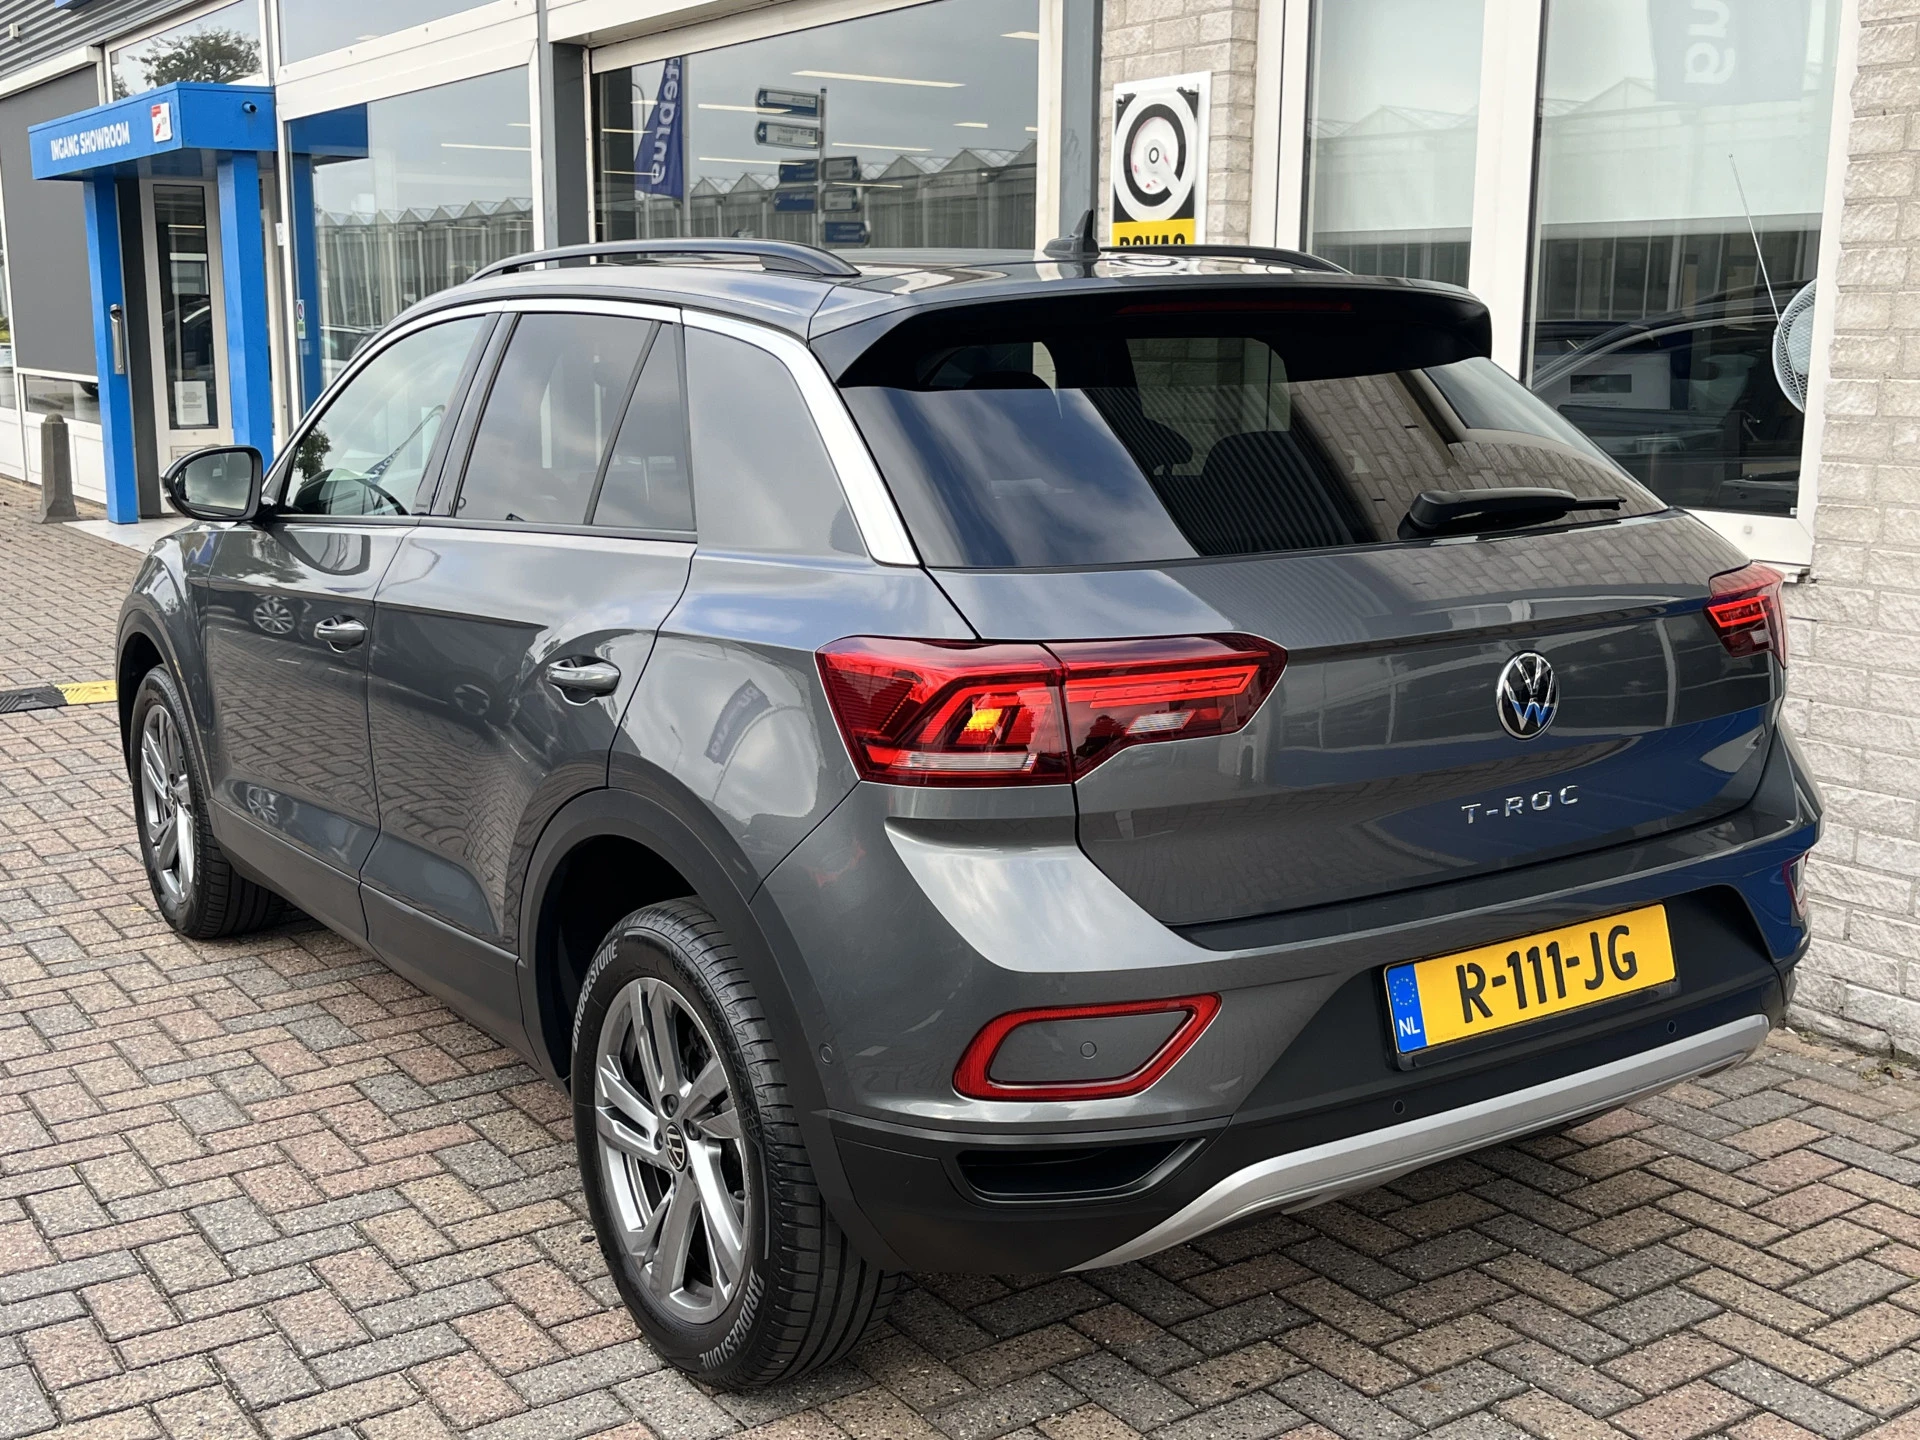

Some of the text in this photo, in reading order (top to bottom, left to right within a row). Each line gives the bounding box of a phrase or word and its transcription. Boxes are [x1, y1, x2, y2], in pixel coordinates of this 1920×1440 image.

[50, 121, 131, 161] INGANG SHOWROOM
[1461, 785, 1579, 824] T-ROC
[572, 938, 618, 1053] BRIDGESTONE
[1456, 925, 1638, 1024] R-111-JG
[1399, 1016, 1421, 1037] NL
[699, 1264, 766, 1370] BRIDGESTONE
